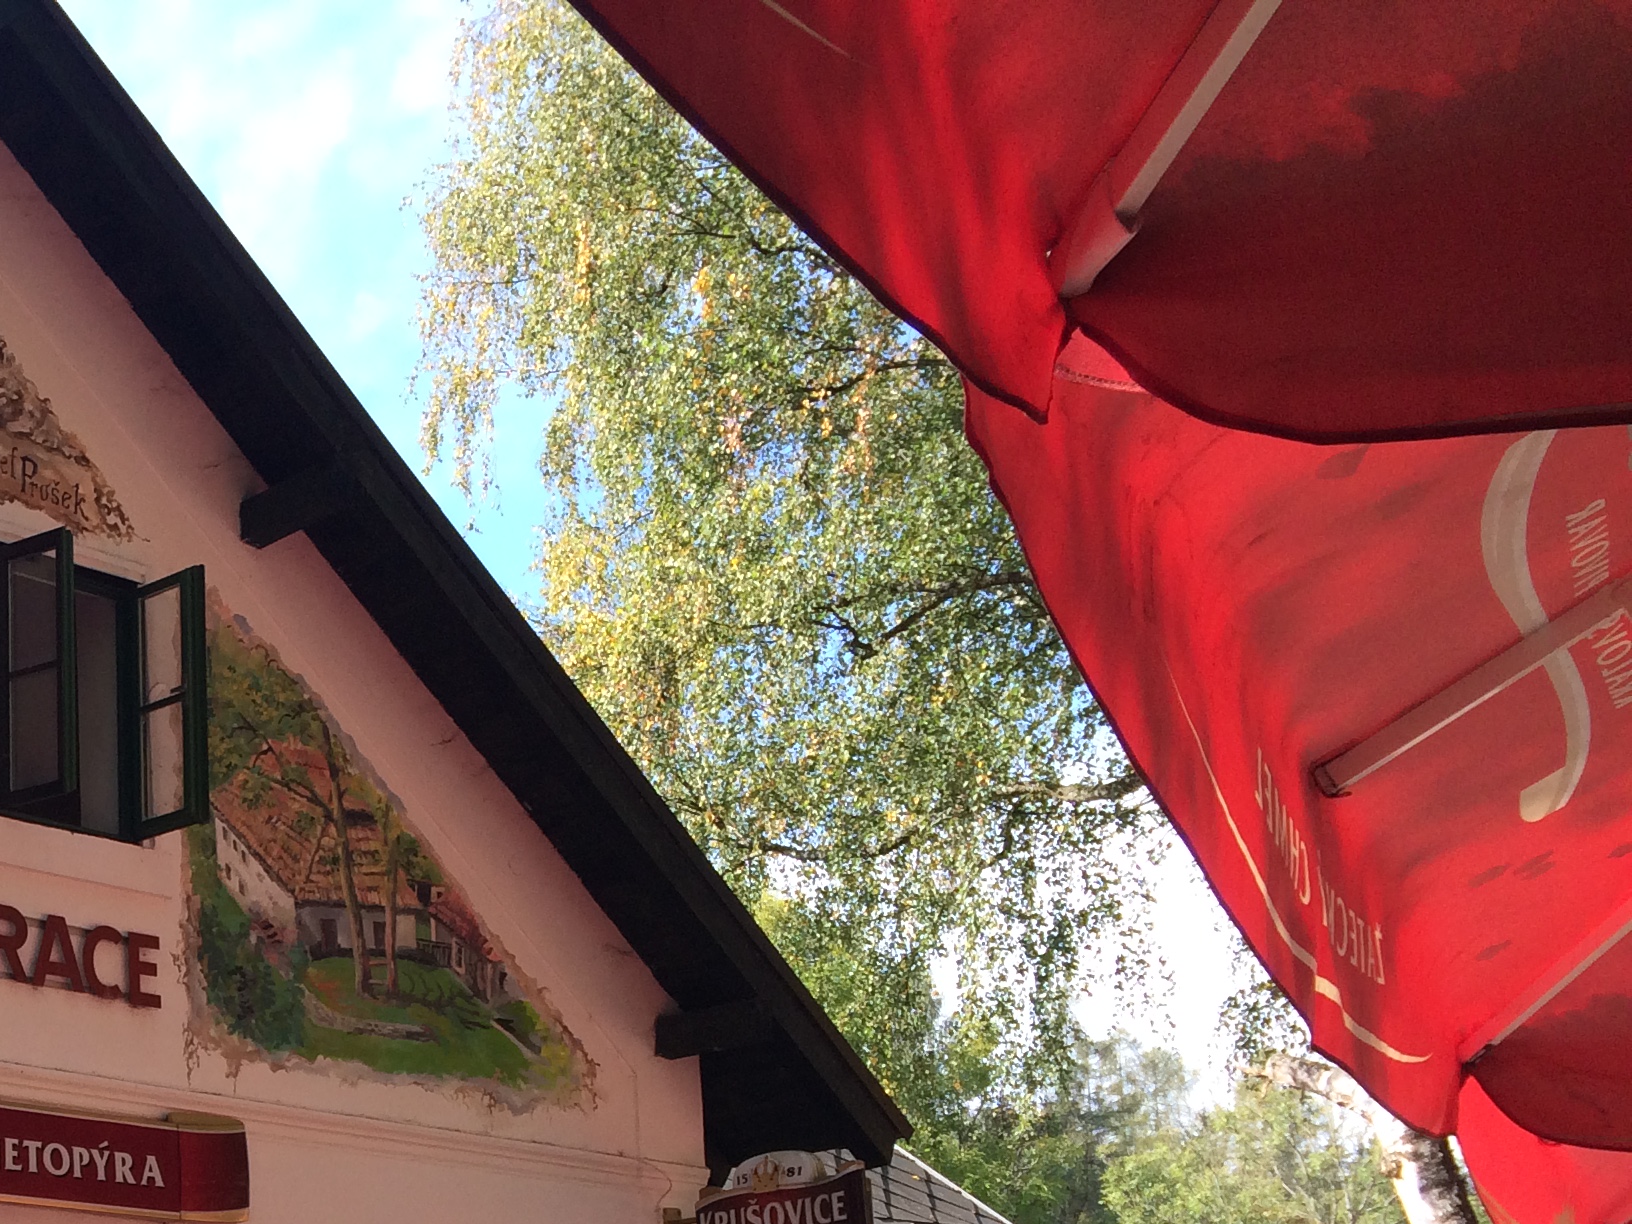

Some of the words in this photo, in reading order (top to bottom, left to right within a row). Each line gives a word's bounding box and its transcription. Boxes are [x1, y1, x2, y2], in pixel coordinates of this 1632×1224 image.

[20, 455, 90, 522] Prošek
[736, 1173, 749, 1186] 15
[785, 1166, 803, 1178] 81
